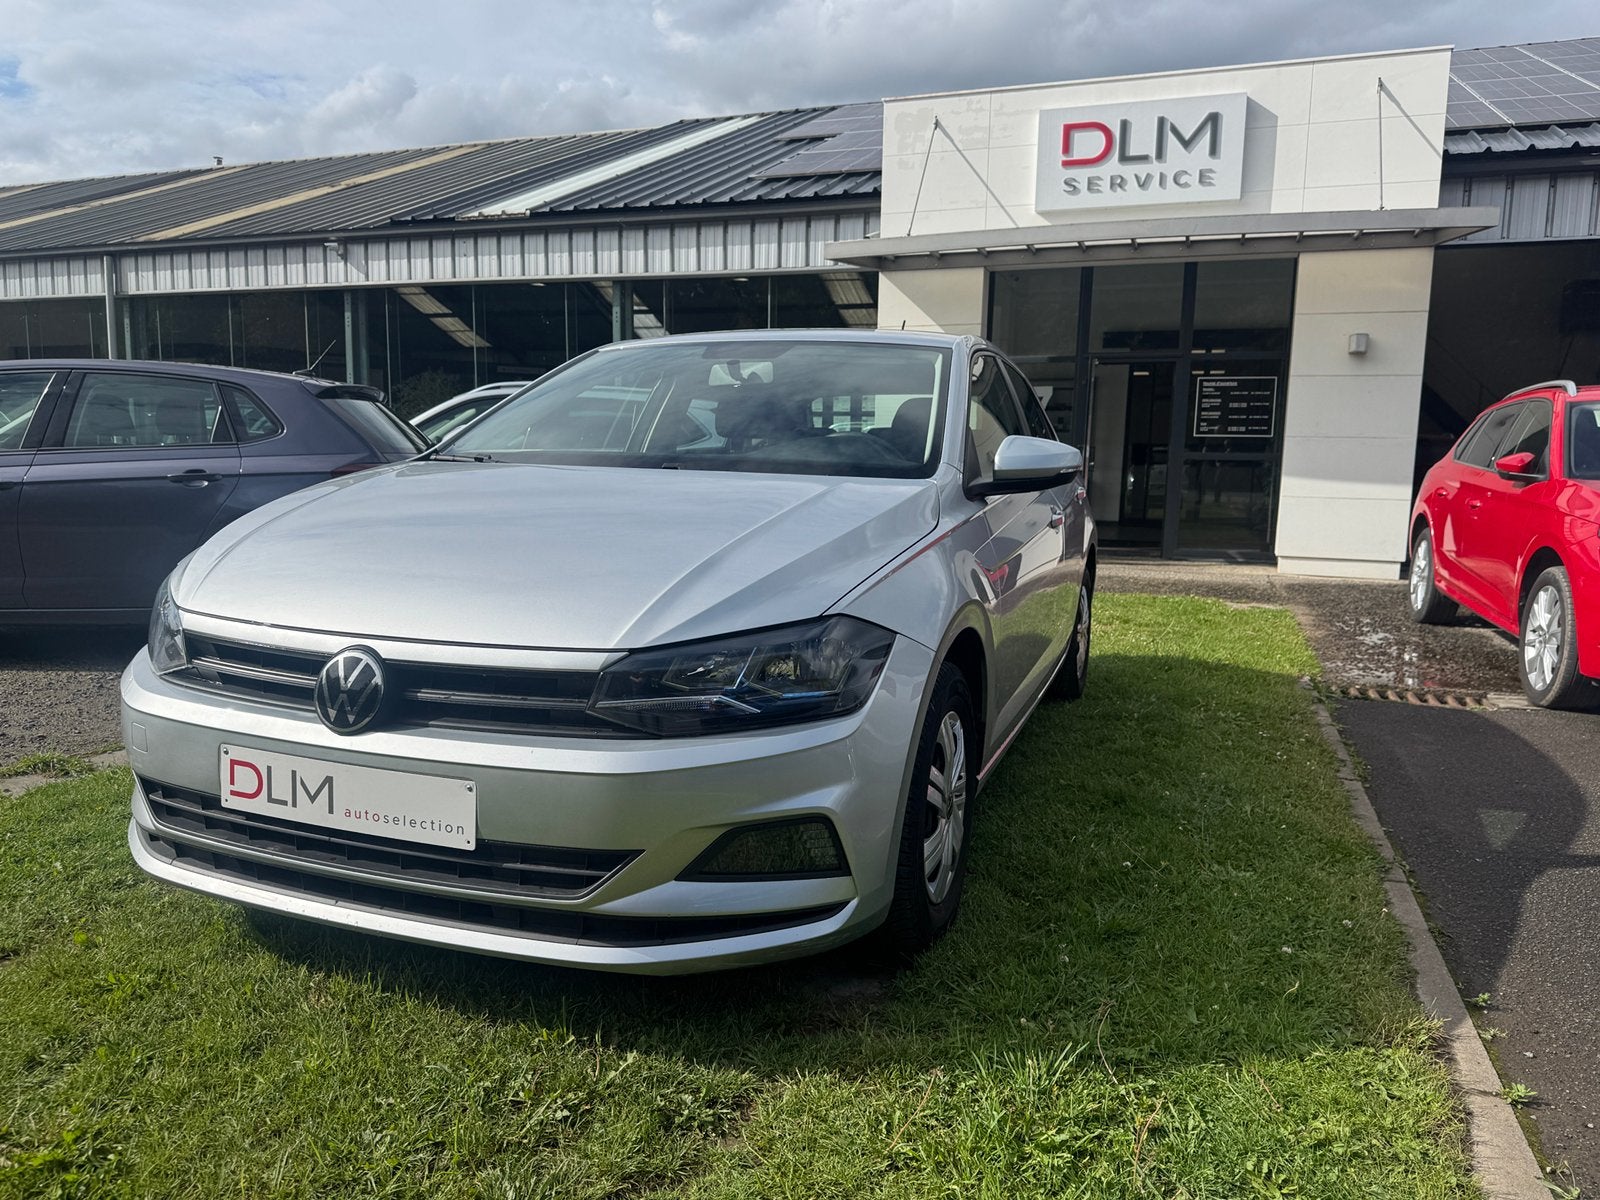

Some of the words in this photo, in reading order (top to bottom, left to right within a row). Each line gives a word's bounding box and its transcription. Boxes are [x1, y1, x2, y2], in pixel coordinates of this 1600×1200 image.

[1061, 111, 1221, 167] DLM
[1063, 168, 1216, 195] SERVICE
[229, 758, 334, 815] DLM
[344, 808, 465, 835] autoselection
